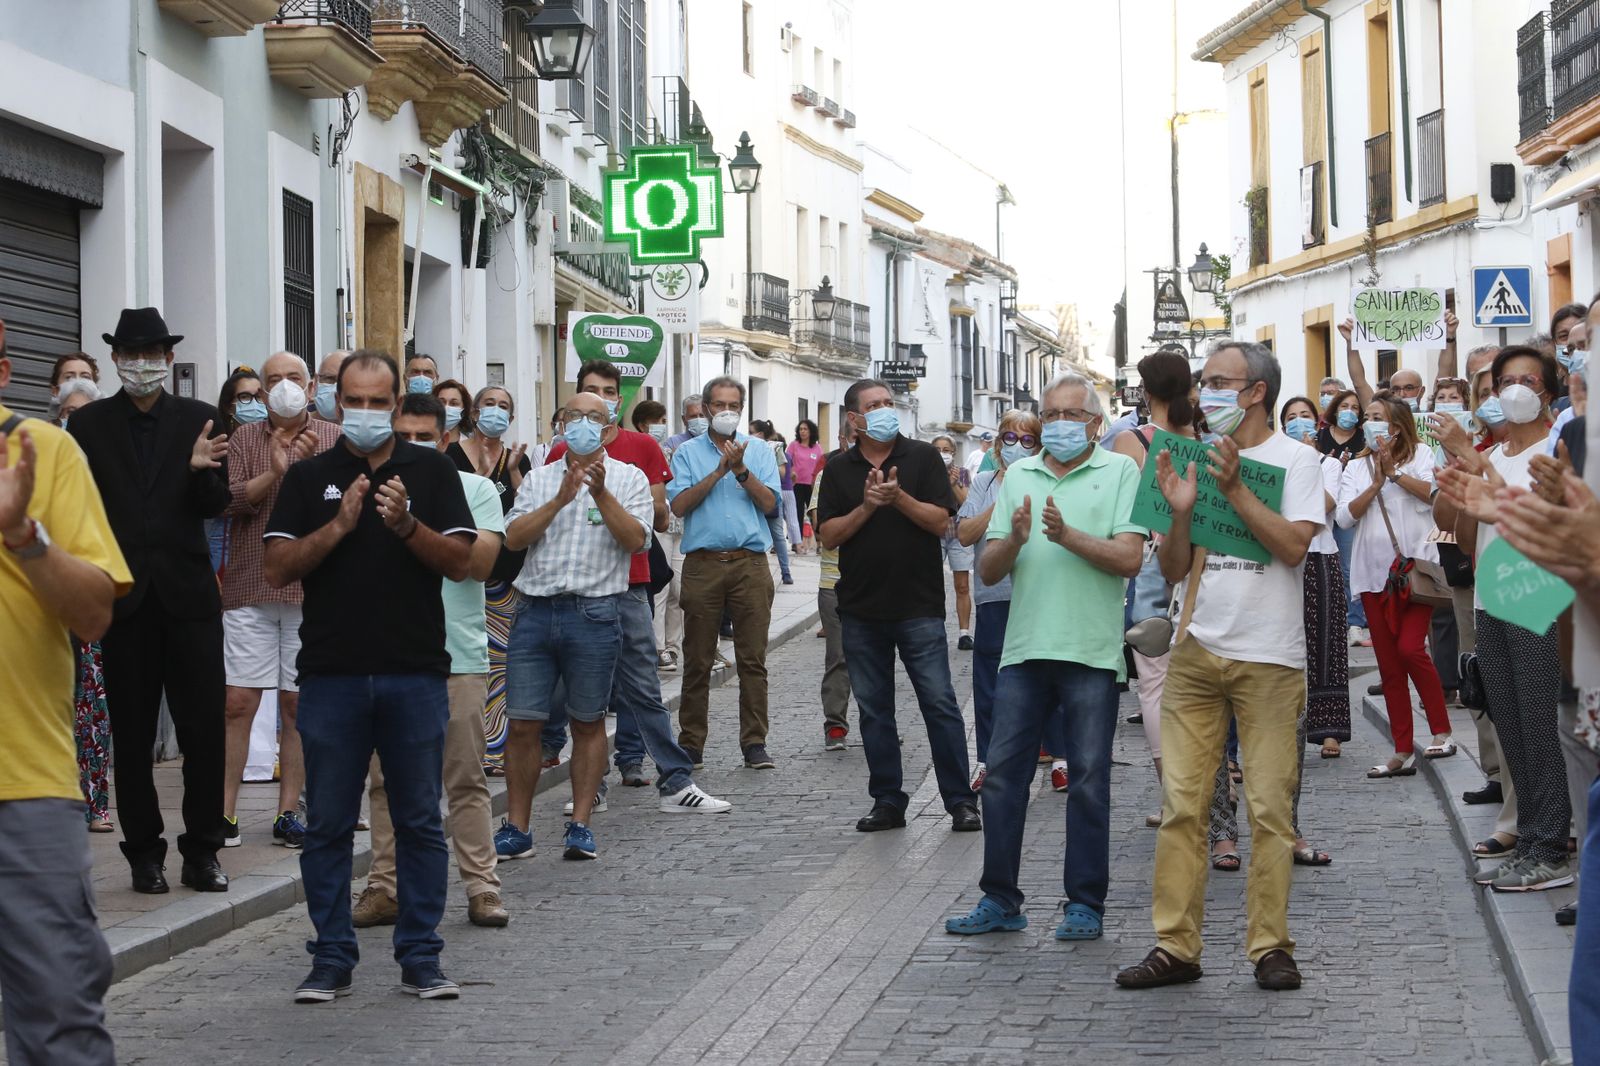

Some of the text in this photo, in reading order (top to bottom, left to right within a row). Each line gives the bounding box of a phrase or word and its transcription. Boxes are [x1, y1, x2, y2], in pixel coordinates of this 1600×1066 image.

[1354, 290, 1440, 312] SANITARI@S
[593, 326, 651, 339] DEFIENDE
[1355, 320, 1444, 343] NECESARI@S
[609, 346, 625, 356] LA
[1211, 496, 1230, 511] QUE
[1193, 511, 1207, 525] DE
